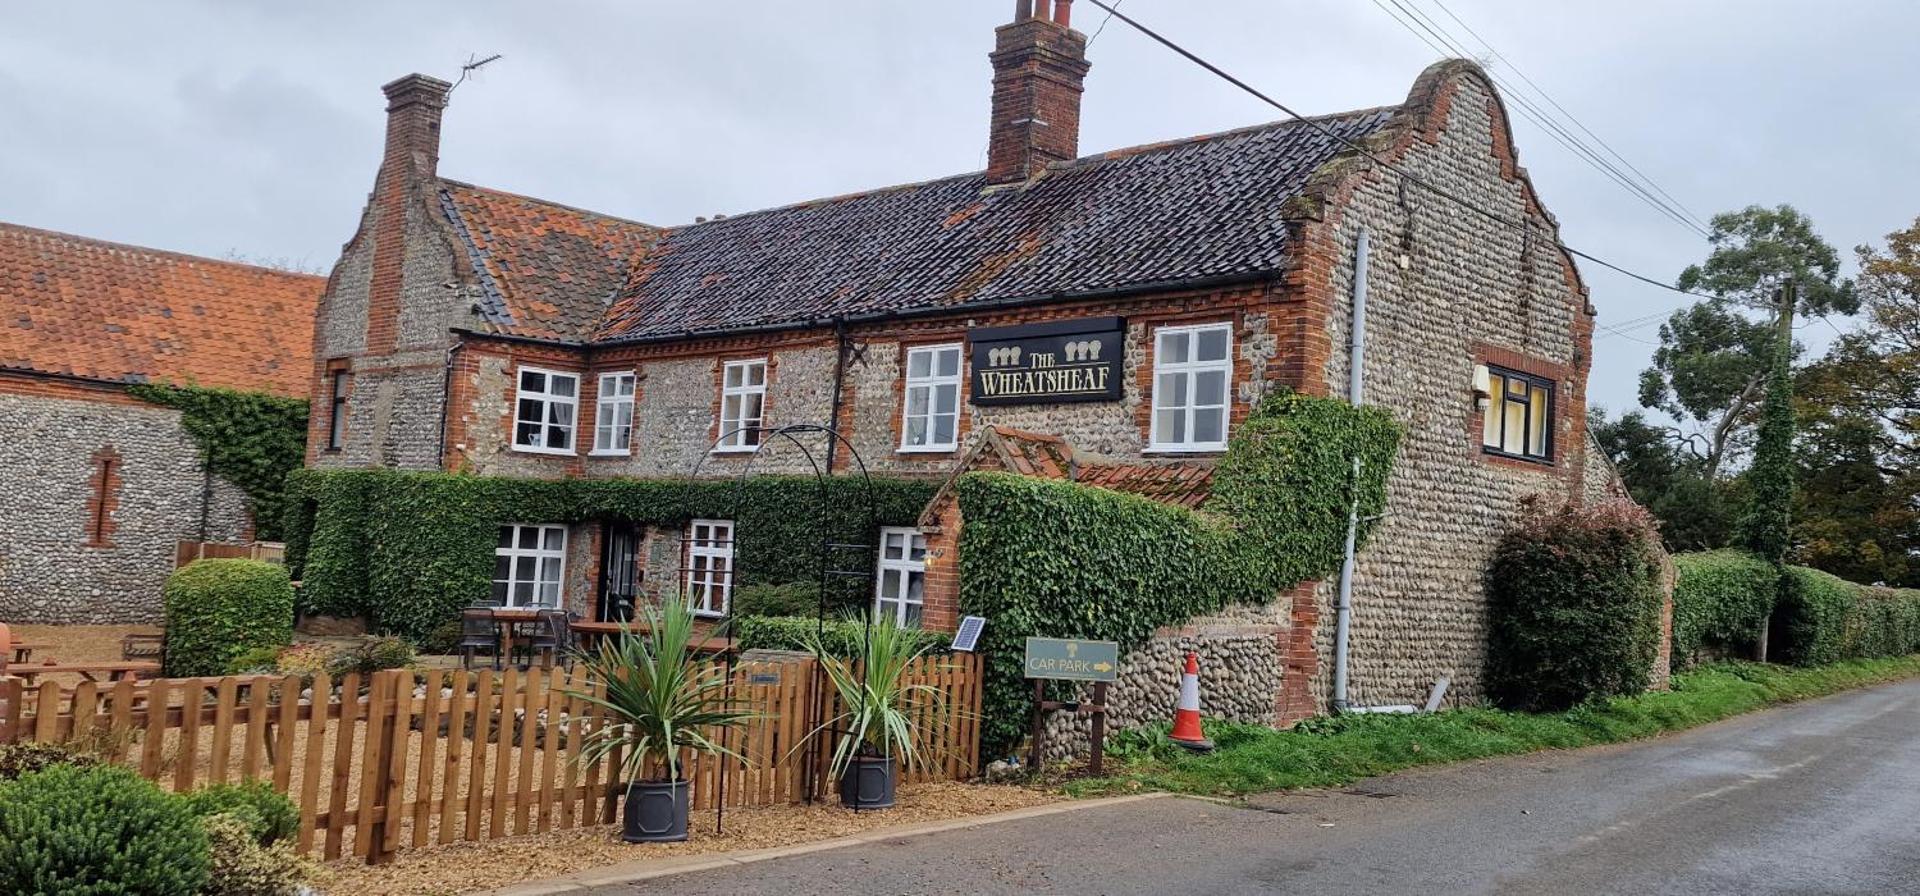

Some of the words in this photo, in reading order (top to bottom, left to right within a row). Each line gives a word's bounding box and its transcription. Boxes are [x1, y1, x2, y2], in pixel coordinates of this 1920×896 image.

[1030, 352, 1056, 369] THE
[981, 367, 1110, 395] WHEATSHEAF
[1029, 657, 1056, 671] CAR
[1060, 659, 1091, 673] PARK
